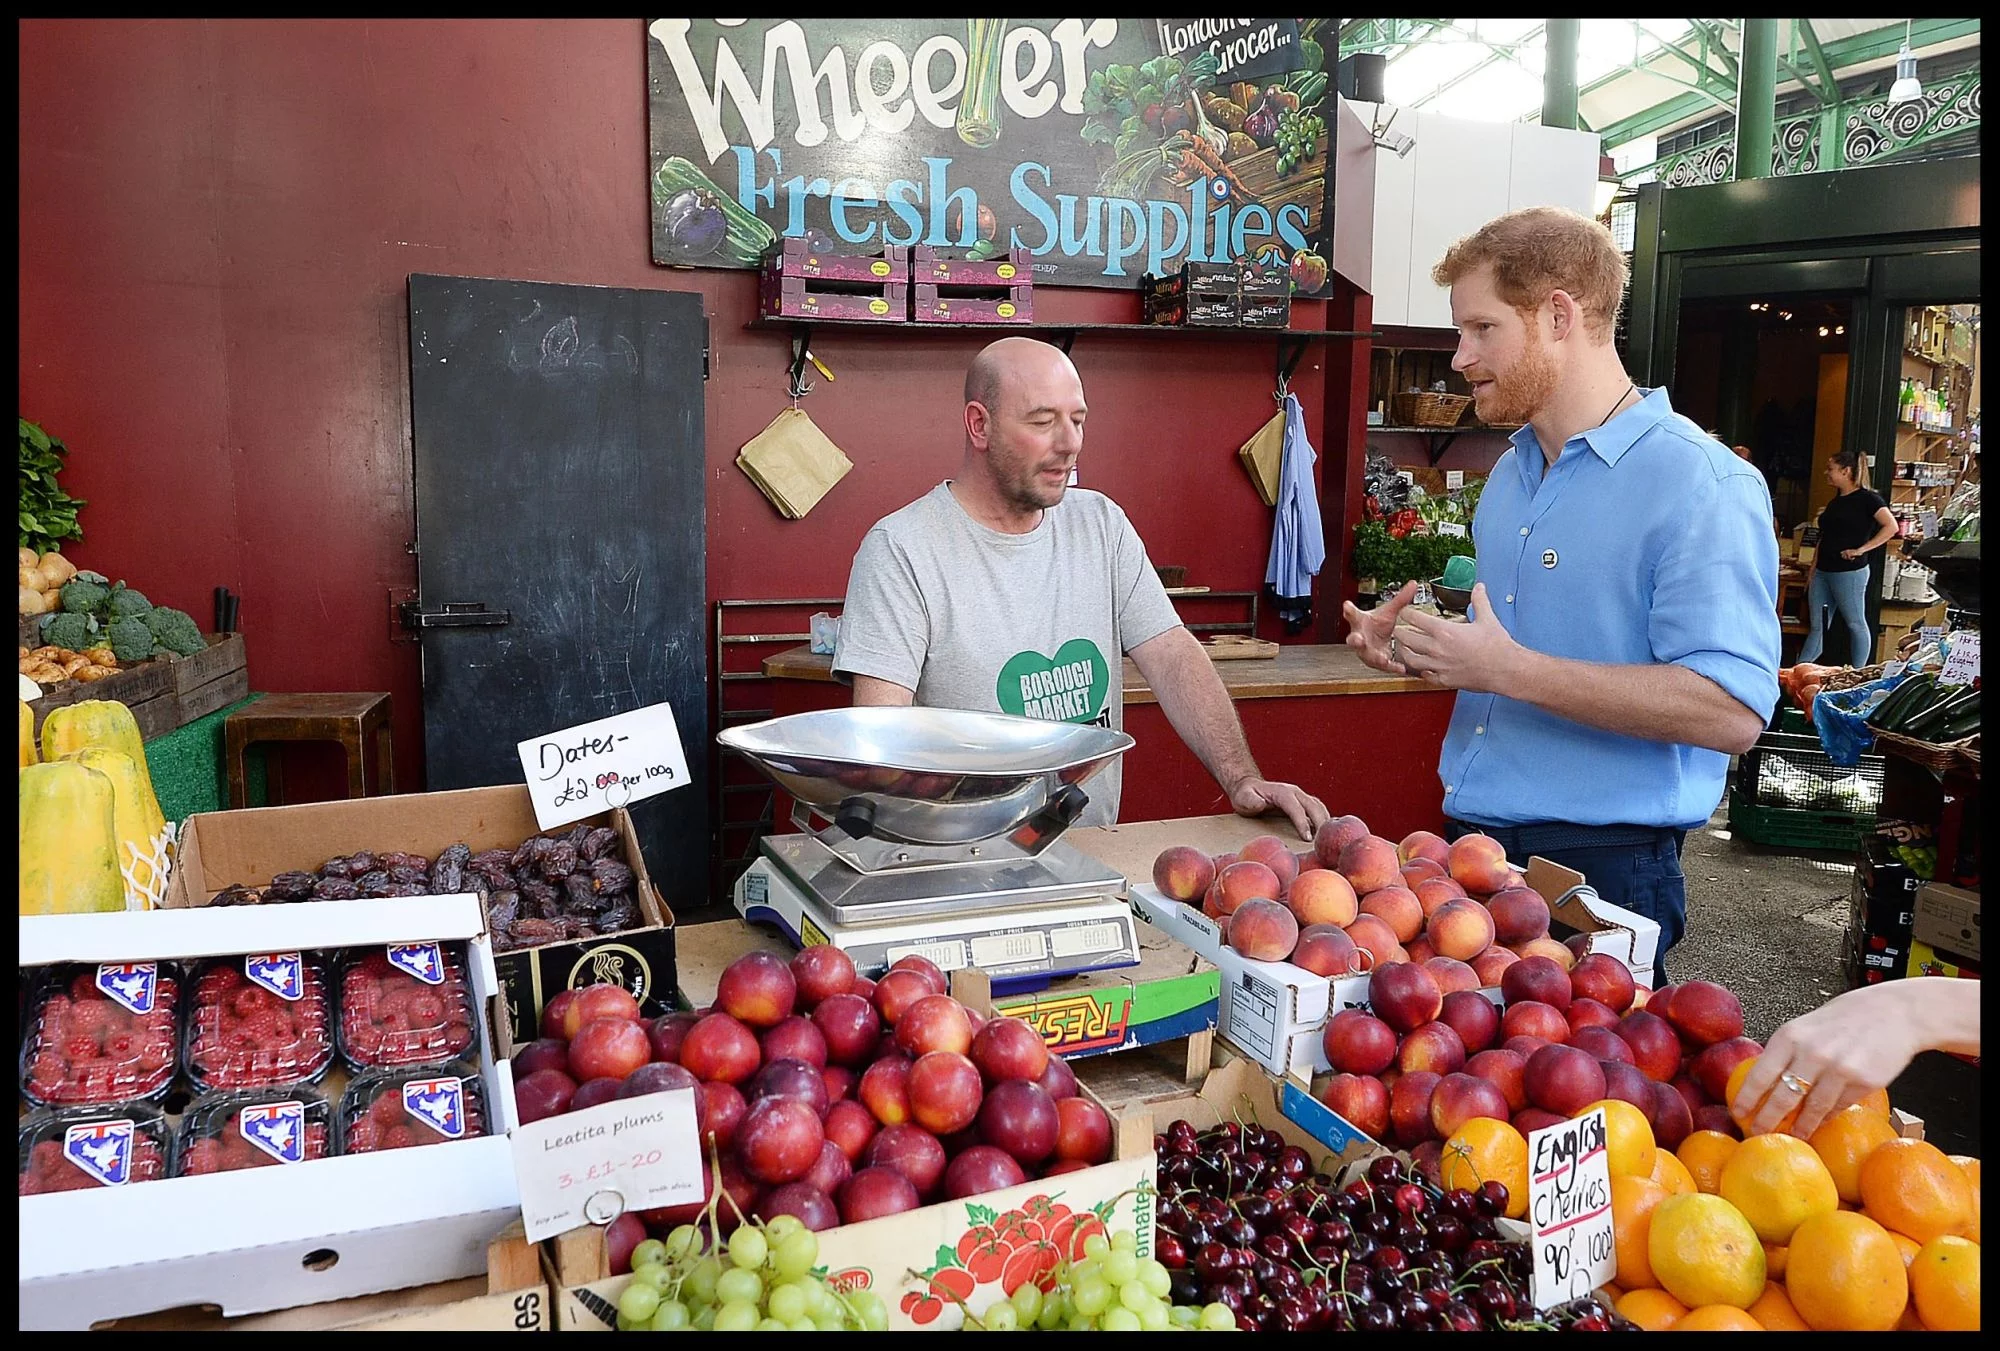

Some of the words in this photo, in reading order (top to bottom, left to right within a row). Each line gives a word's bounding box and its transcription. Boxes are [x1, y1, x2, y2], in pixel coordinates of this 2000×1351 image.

[731, 145, 980, 249] Fresh
[1010, 162, 1314, 278] Supplies
[1020, 659, 1093, 701] BOROUGH
[1024, 687, 1090, 720] MARKET
[621, 775, 641, 790] per
[645, 764, 673, 780] 100g
[613, 1110, 664, 1136] plums
